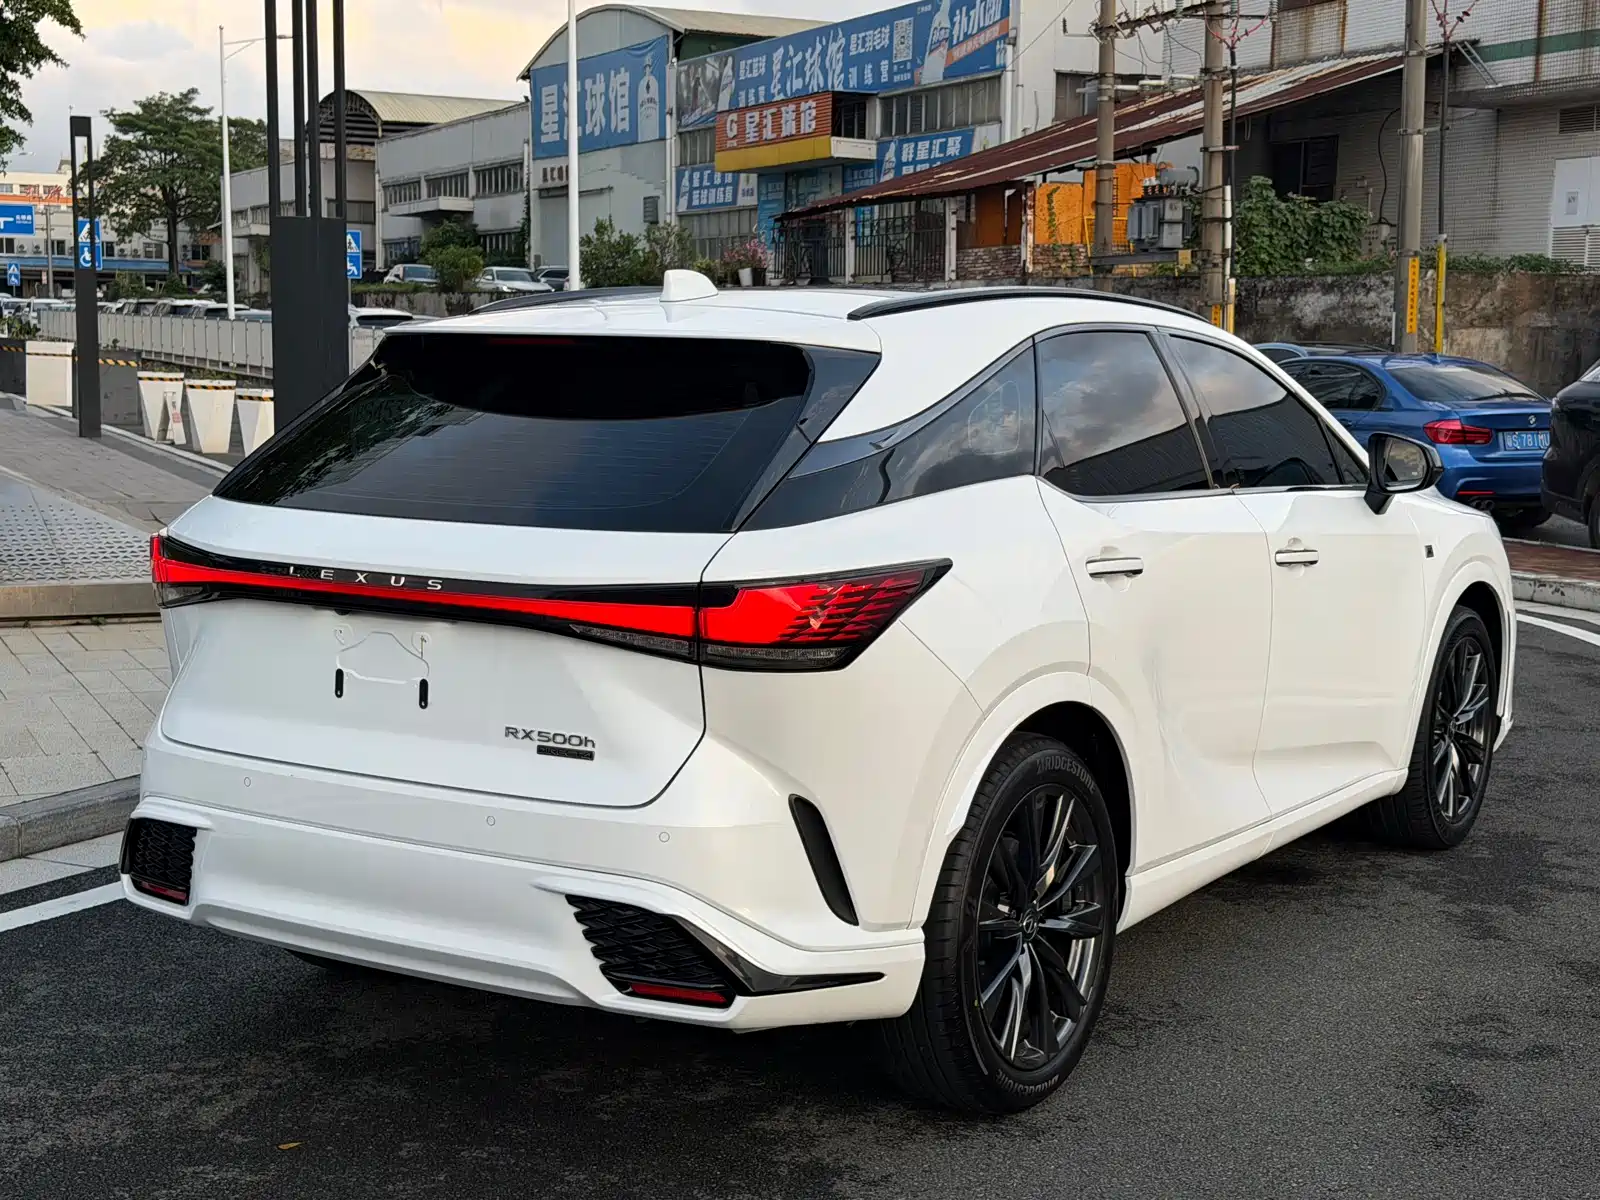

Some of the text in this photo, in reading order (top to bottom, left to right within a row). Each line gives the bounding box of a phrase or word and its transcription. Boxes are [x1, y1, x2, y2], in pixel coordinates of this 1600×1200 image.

[901, 136, 962, 163] 群星汇聚
[289, 565, 443, 591] LEXUS
[504, 726, 595, 749] RX500h
[1036, 756, 1097, 795] BRIDGESTONE
